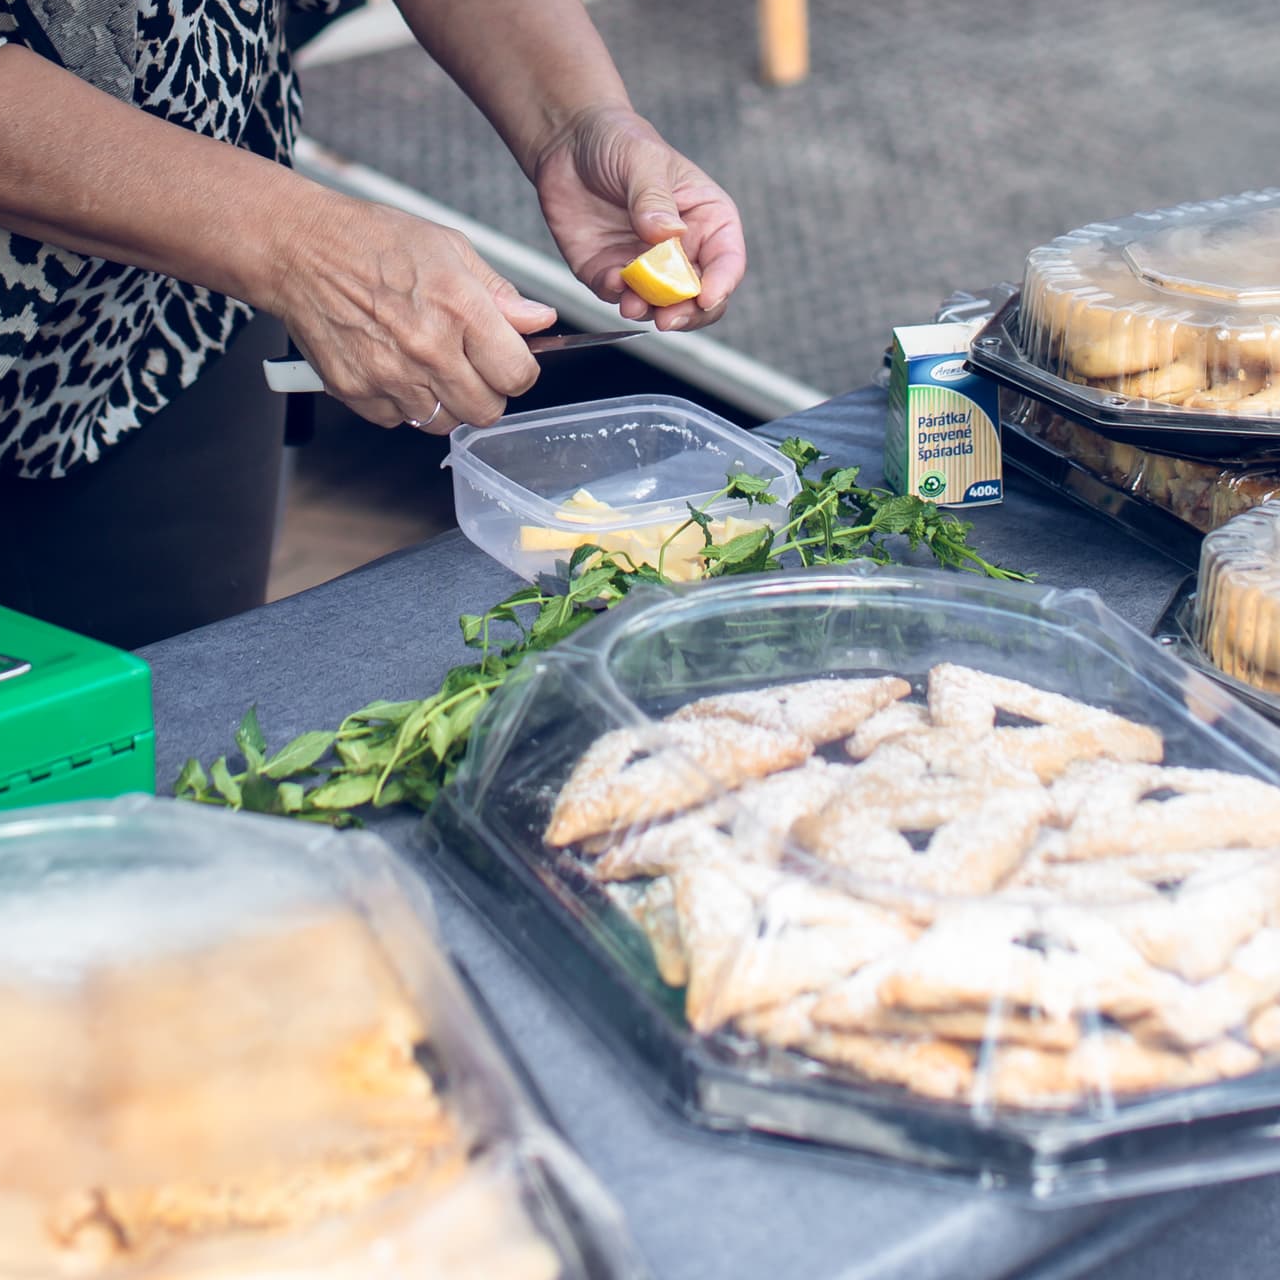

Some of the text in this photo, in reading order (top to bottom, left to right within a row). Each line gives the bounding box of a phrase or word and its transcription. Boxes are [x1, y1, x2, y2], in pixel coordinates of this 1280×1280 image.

[918, 409, 972, 428] Párátka/
[918, 424, 972, 444] Drevené
[918, 440, 973, 461] špáradlá
[969, 484, 999, 498] 400x
